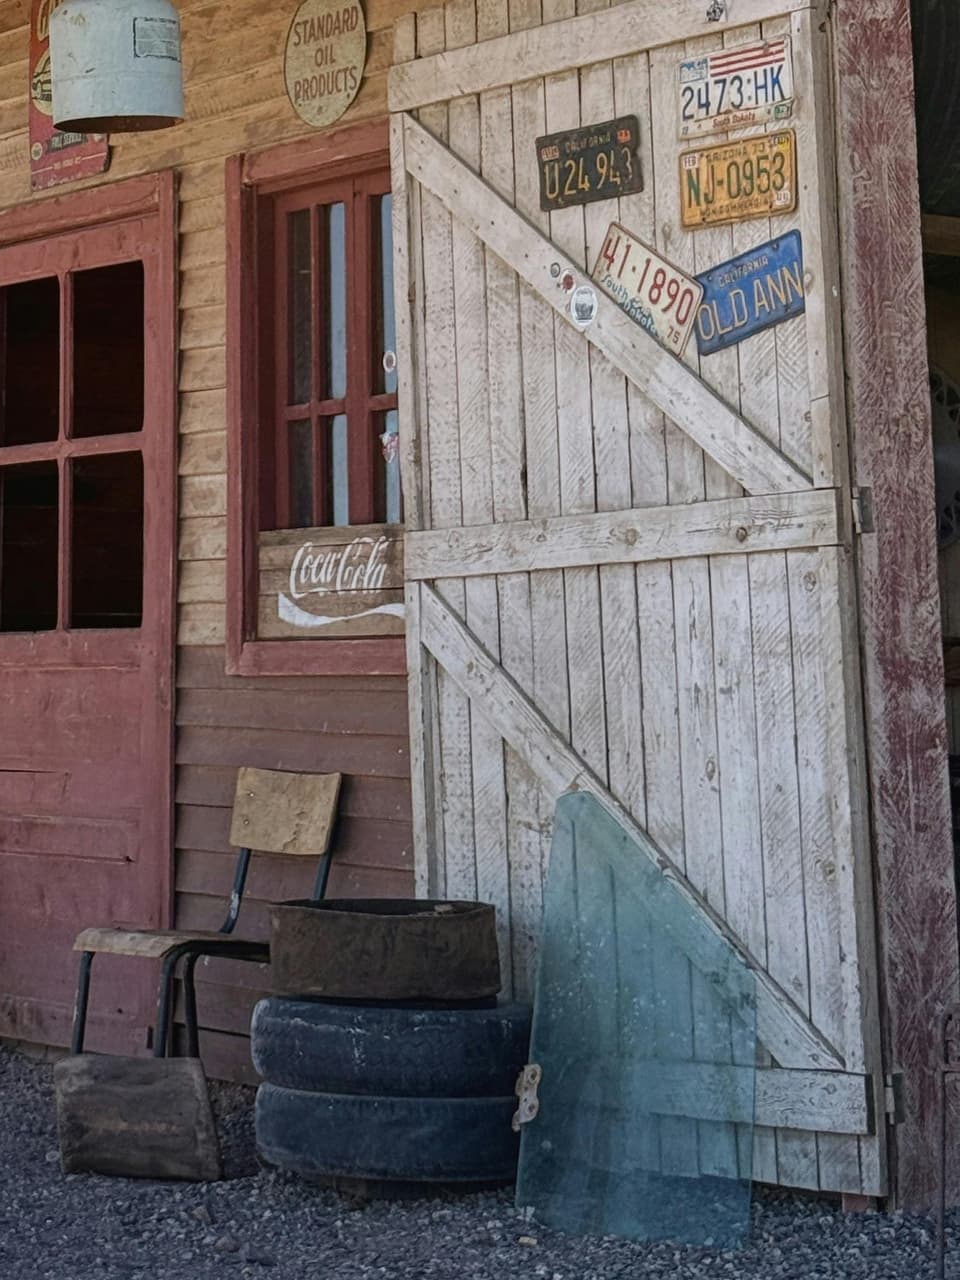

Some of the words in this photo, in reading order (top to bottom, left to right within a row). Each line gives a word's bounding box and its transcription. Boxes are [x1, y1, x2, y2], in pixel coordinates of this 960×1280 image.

[292, 6, 359, 47] STANDARD
[314, 44, 337, 68] OIL
[294, 66, 358, 103] PRODUCTS
[685, 151, 786, 210] NJ-0953
[719, 255, 769, 288] CALIFORNIA
[697, 288, 749, 341] OLD
[753, 261, 804, 321] ANN
[666, 325, 681, 345] 75
